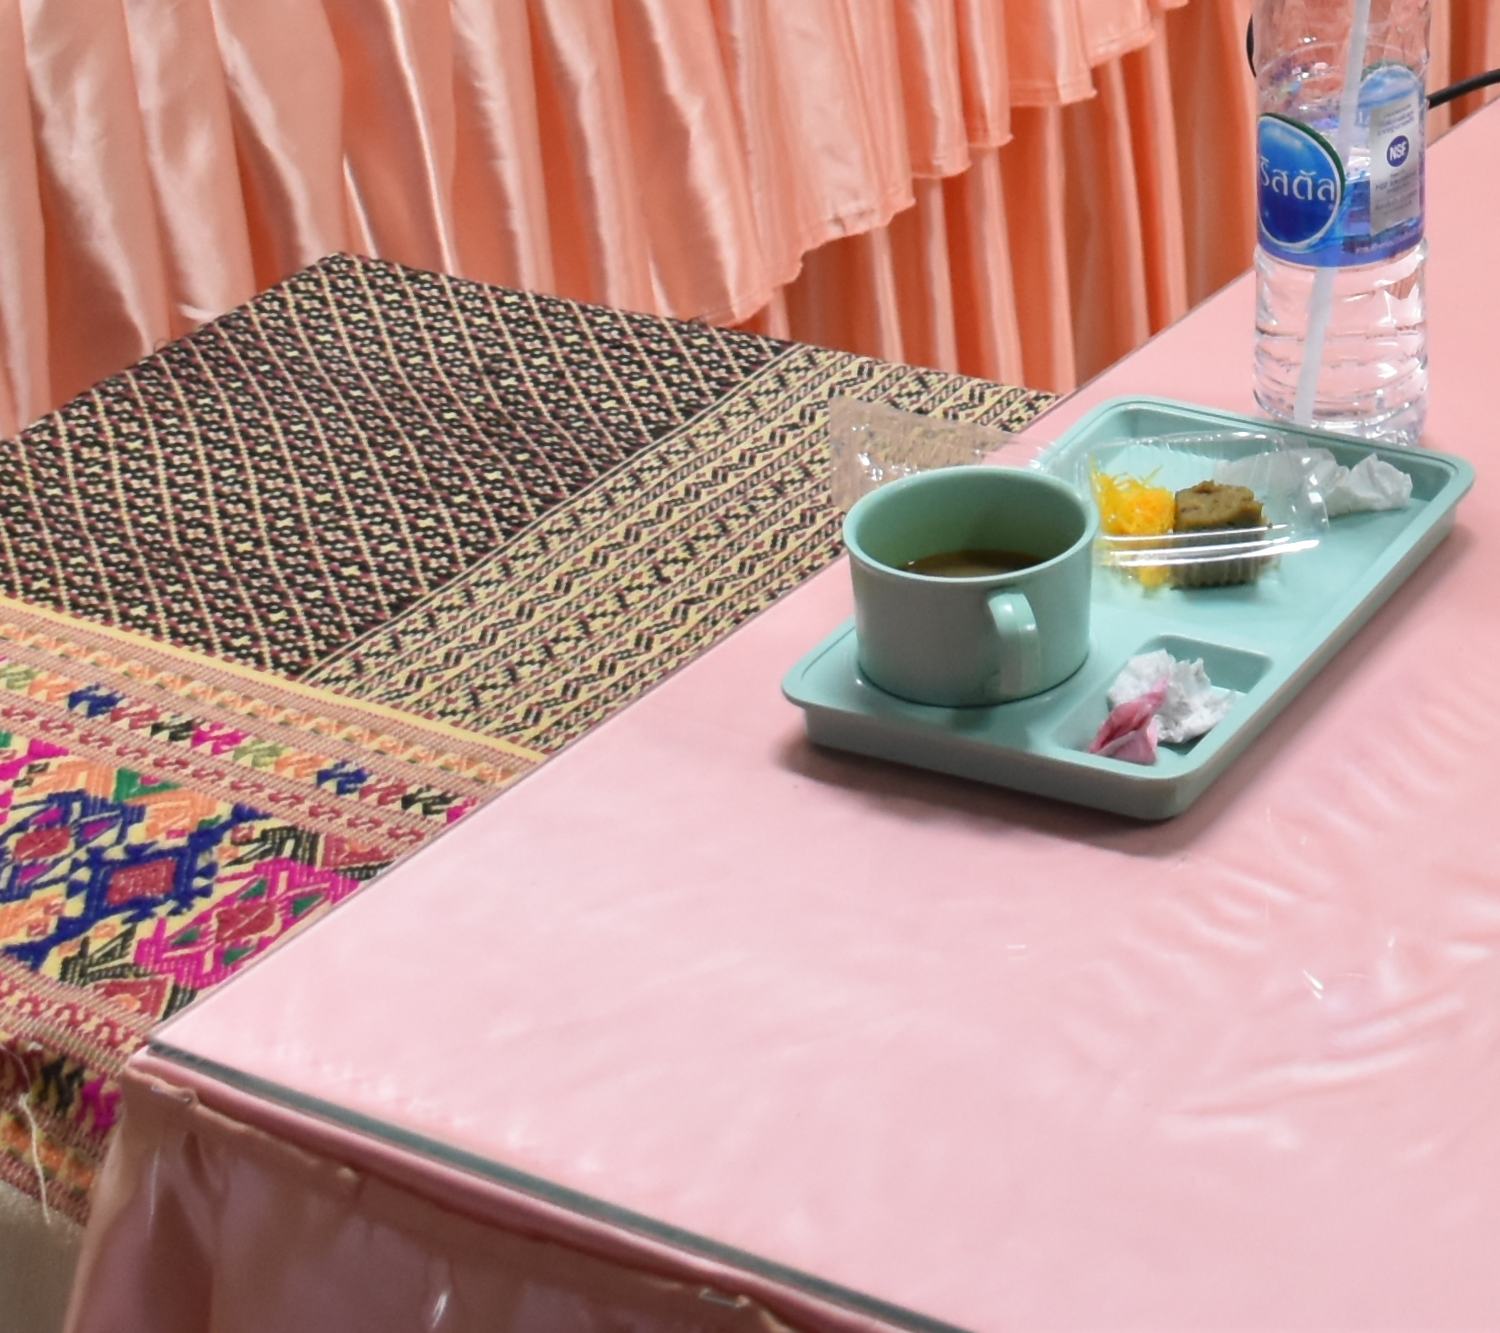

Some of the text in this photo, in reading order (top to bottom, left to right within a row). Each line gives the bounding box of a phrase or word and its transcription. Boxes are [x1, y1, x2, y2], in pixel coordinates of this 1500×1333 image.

[1389, 141, 1407, 161] NSF
[1260, 155, 1336, 202] ริสตัล
